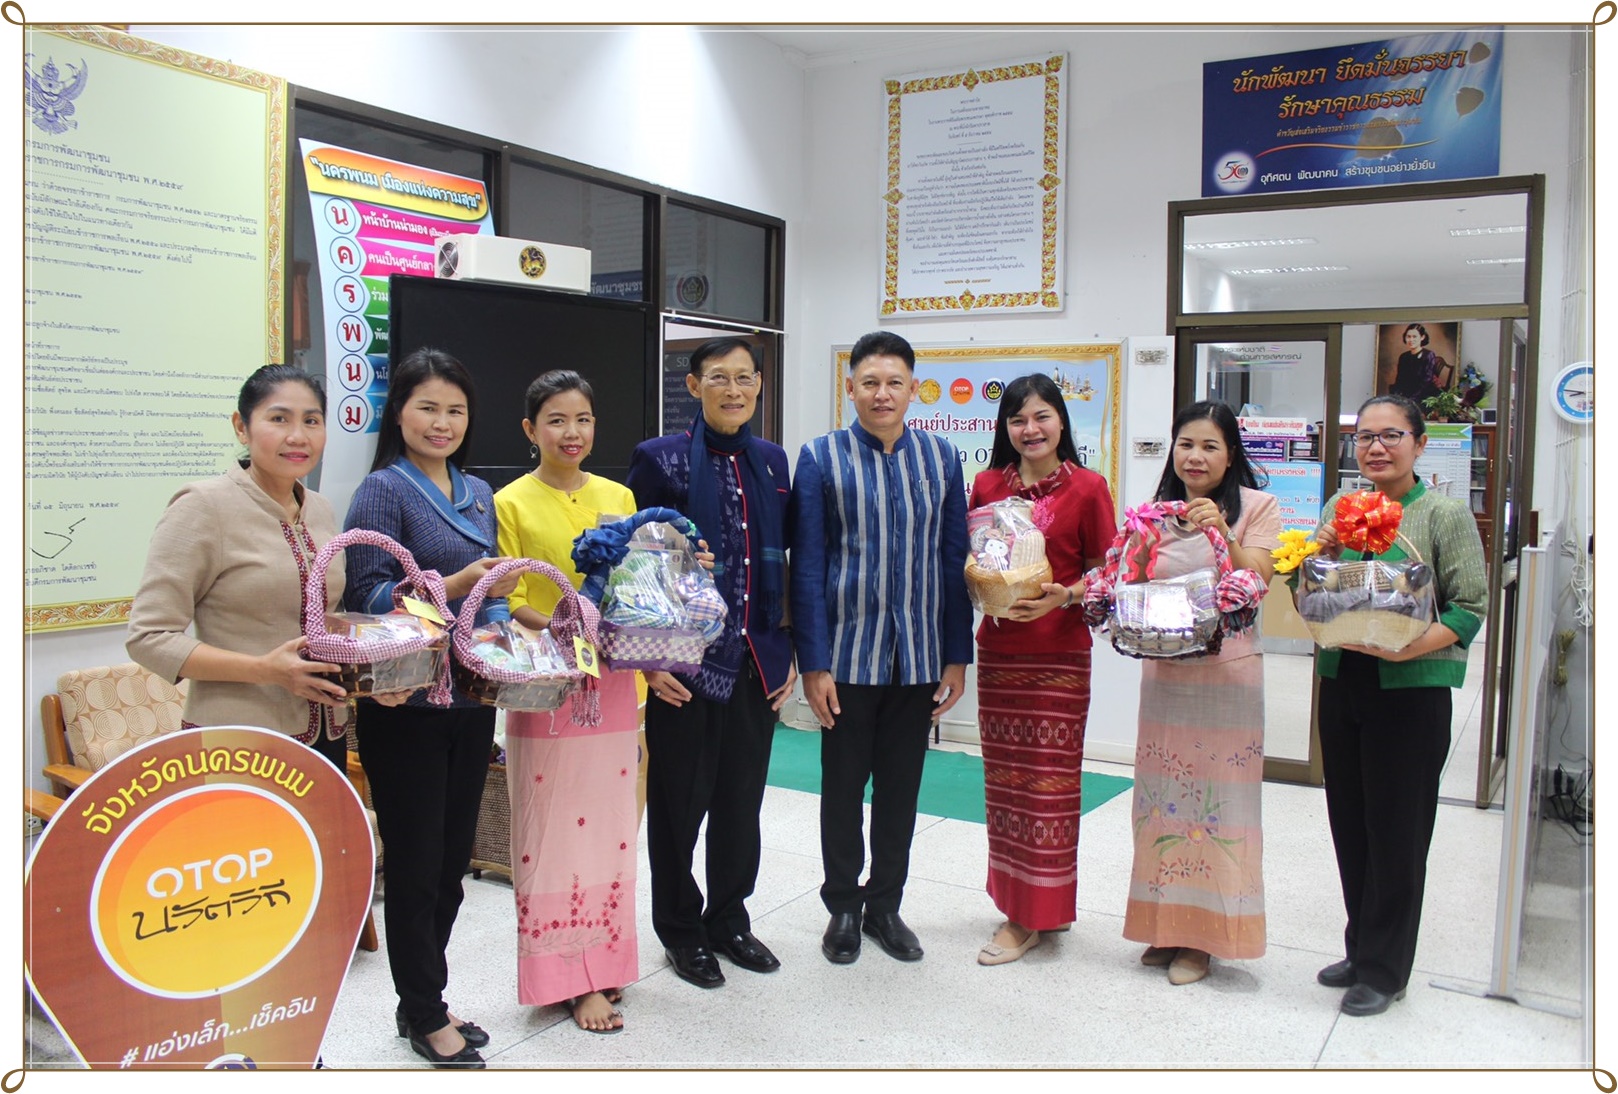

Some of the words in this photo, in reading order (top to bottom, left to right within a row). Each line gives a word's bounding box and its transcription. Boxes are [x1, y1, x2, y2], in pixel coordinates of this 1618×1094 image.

[1232, 63, 1327, 94] นักพัฒนา
[1335, 46, 1468, 81] ยึดมั่นจรรยา
[1277, 85, 1427, 121] รักษาคุณธรรม
[1259, 170, 1292, 185] อุทิศตน
[1297, 168, 1339, 181] พัฒนาคน
[1344, 159, 1437, 178] สร้างชุมชนอย่างยั่งยืน
[331, 206, 350, 226] น
[336, 245, 354, 265] ค
[368, 251, 433, 273] คนเป็นศูนย์กลา
[344, 284, 356, 304] ร
[342, 321, 362, 343] พ
[345, 364, 361, 382] น
[345, 405, 361, 426] ม
[907, 411, 998, 432] ศนย์ประสาน
[81, 747, 315, 837] จังหวัดนครพนม
[145, 847, 274, 899] OTOP
